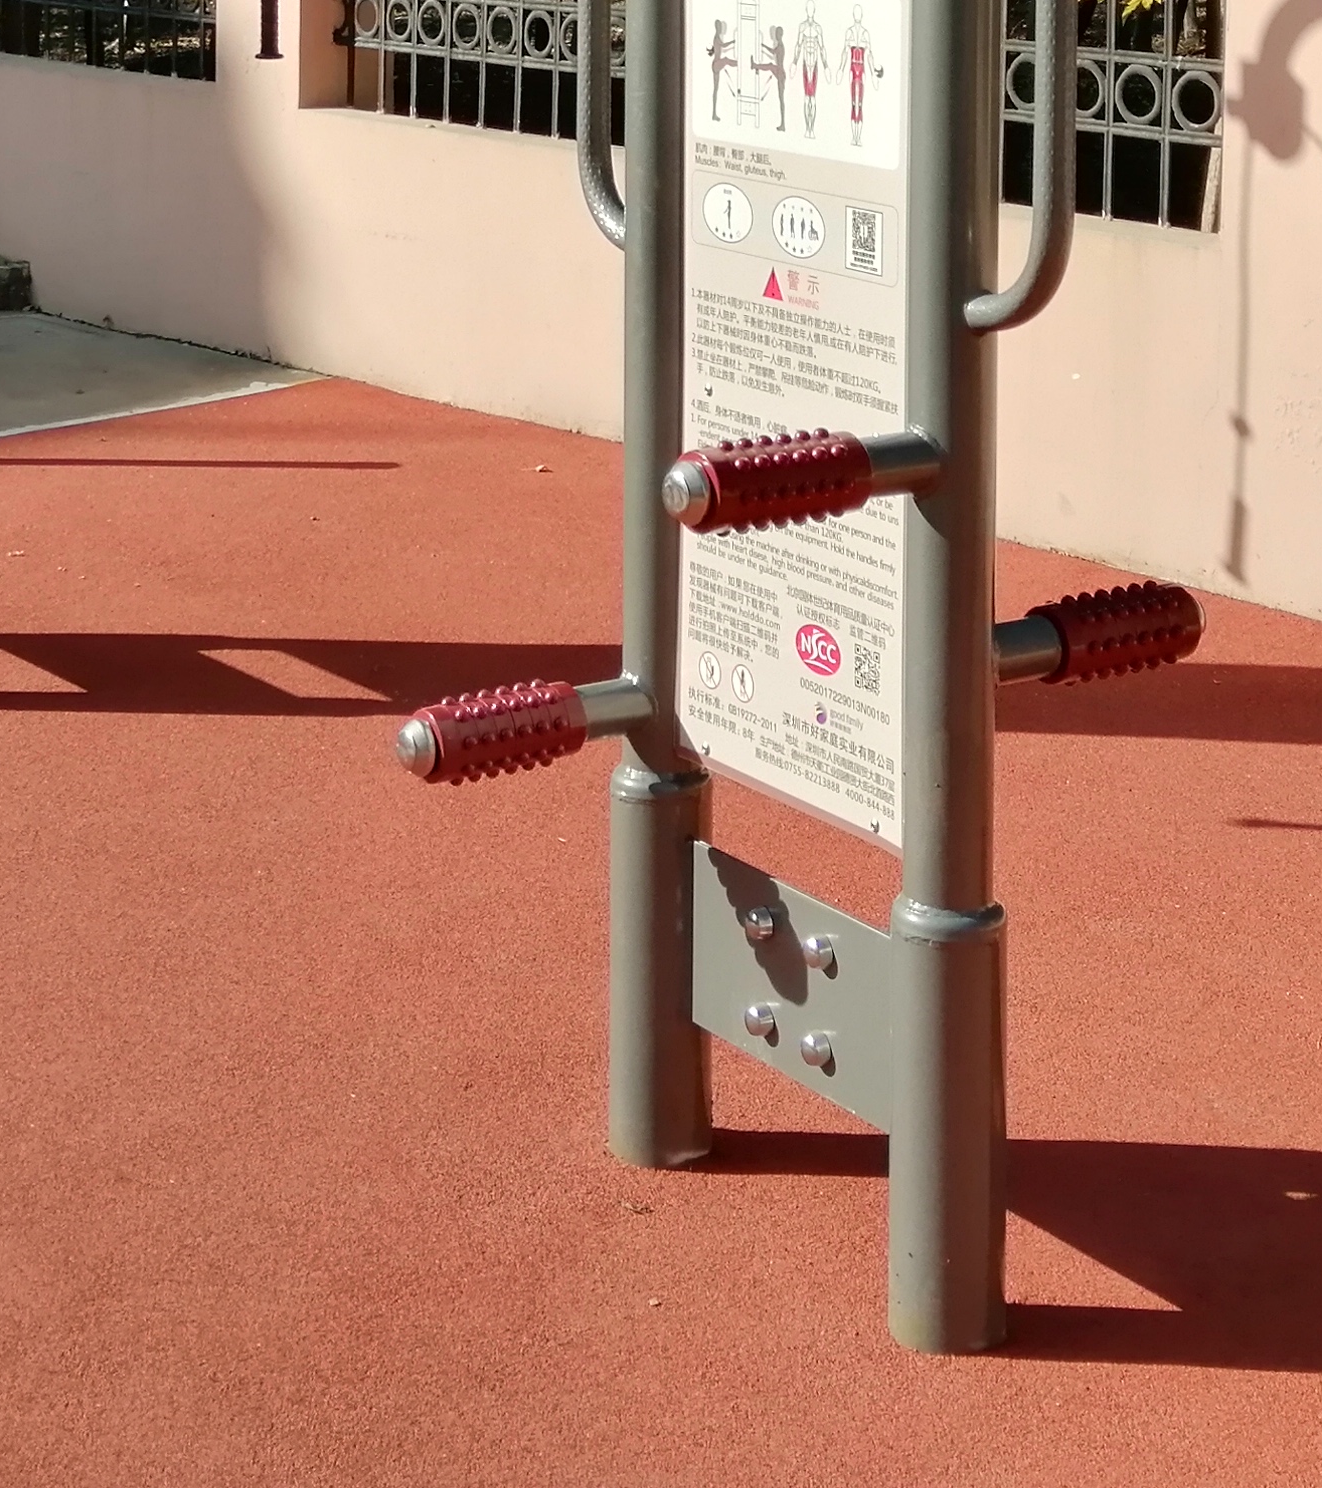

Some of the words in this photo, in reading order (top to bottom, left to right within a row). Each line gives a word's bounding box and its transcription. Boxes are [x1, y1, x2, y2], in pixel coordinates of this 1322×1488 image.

[697, 414, 707, 425] For
[708, 420, 731, 433] persons
[732, 427, 749, 438] under
[865, 507, 877, 518] due
[879, 511, 886, 521] to
[876, 498, 884, 506] or
[884, 499, 894, 510] be
[828, 518, 837, 529] for
[838, 523, 850, 533] one
[851, 527, 871, 541] person
[872, 535, 884, 546] and
[885, 538, 896, 550] the
[696, 540, 716, 555] should
[718, 548, 726, 558] be
[727, 553, 745, 565] under
[746, 558, 757, 570] the
[732, 540, 747, 554] heart
[771, 555, 785, 569] high
[787, 559, 805, 575] blood
[835, 580, 847, 592] and
[848, 585, 865, 598] other
[746, 533, 755, 546] the
[756, 540, 780, 555] machine
[781, 548, 794, 560] after
[796, 553, 819, 571] drinking
[820, 563, 827, 572] or
[828, 566, 841, 578] with
[831, 542, 844, 555] Hold
[846, 548, 855, 560] the
[856, 550, 878, 568] handles
[879, 559, 896, 577] firmly
[801, 629, 836, 664] NSCC
[782, 711, 895, 775] 深圳市好家庭实业有限公司
